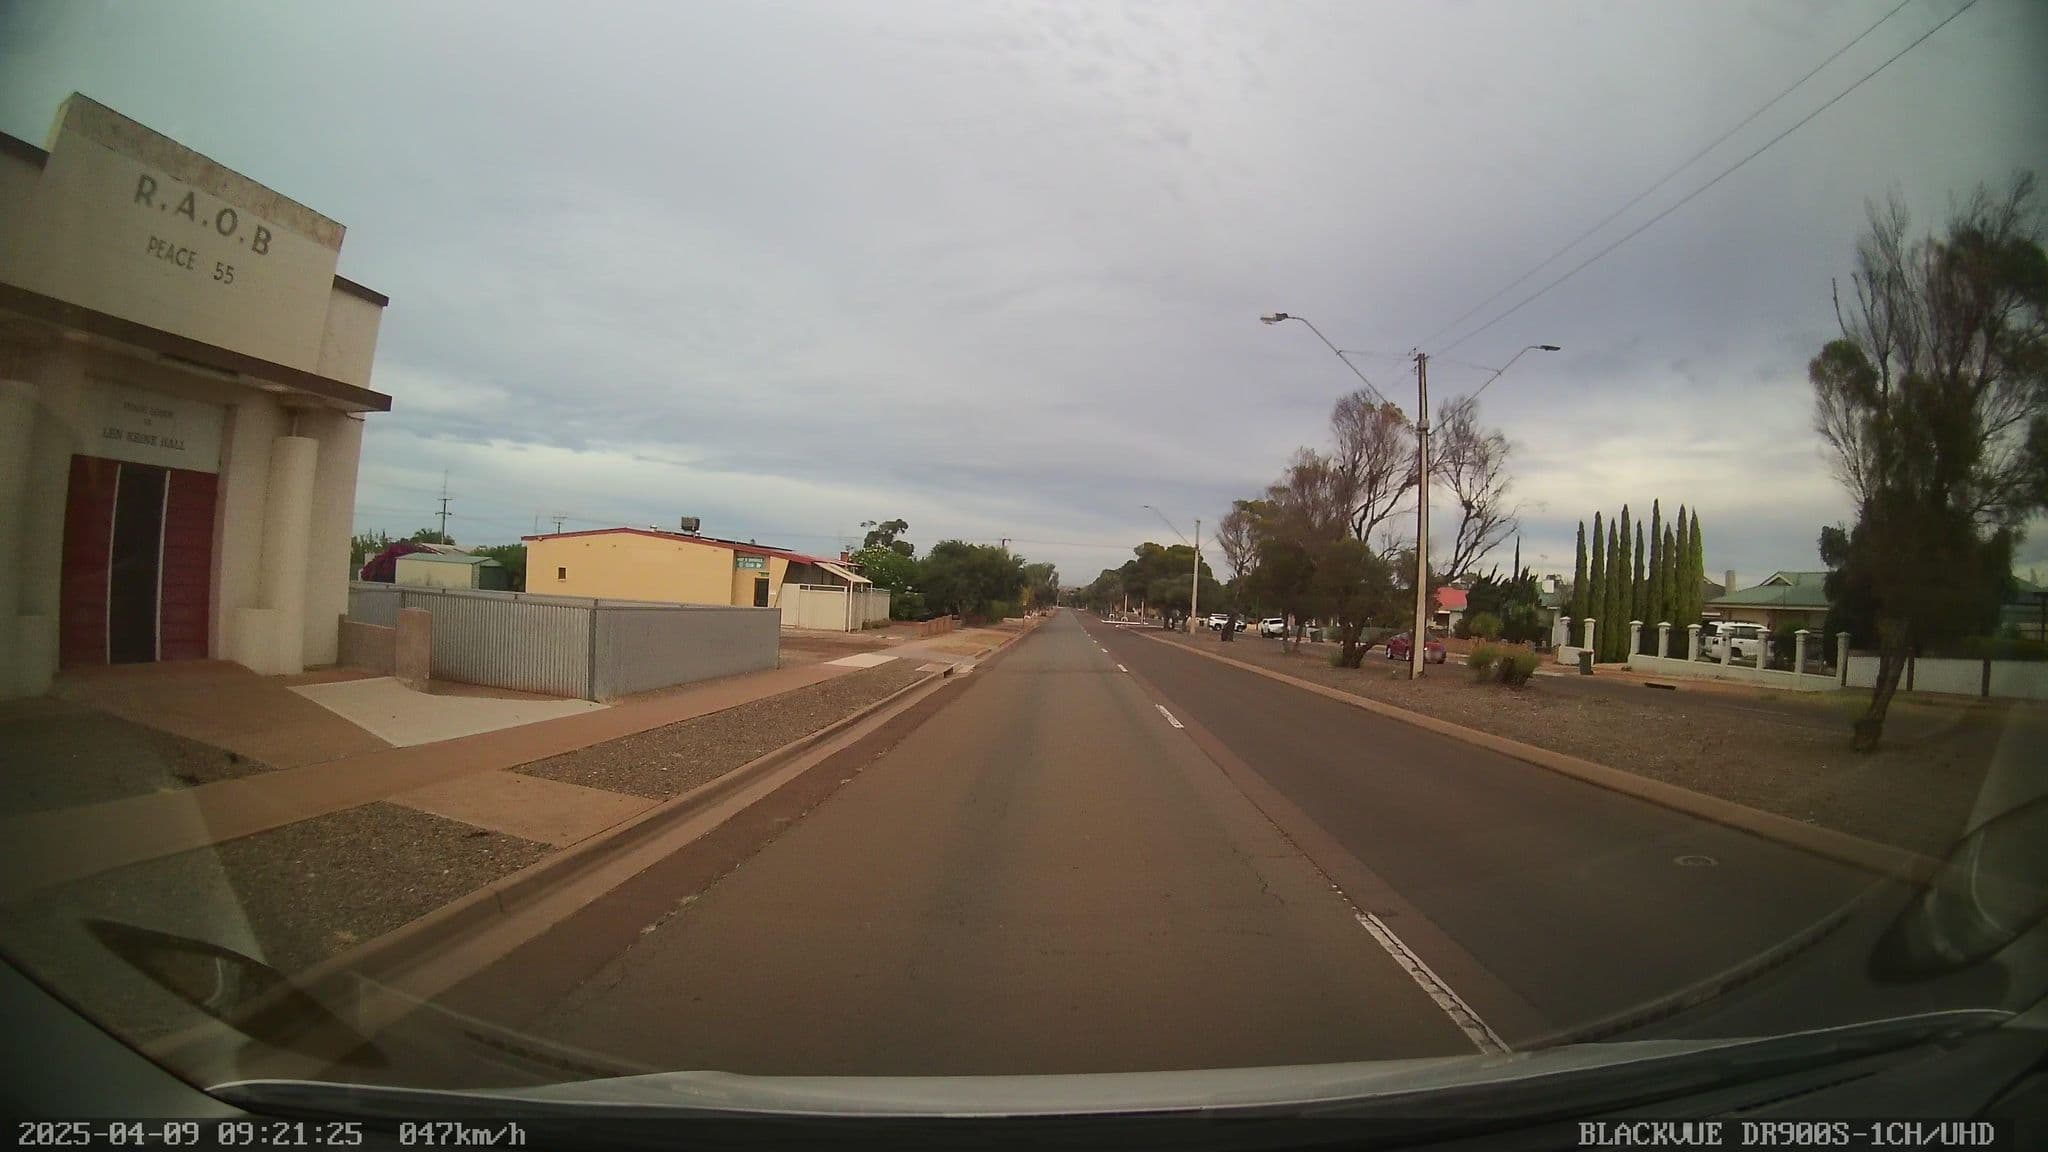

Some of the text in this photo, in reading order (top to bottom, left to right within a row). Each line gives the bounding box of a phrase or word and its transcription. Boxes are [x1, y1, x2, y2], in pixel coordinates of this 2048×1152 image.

[134, 174, 272, 256] R.A.O.B
[147, 235, 235, 285] PEACE 55
